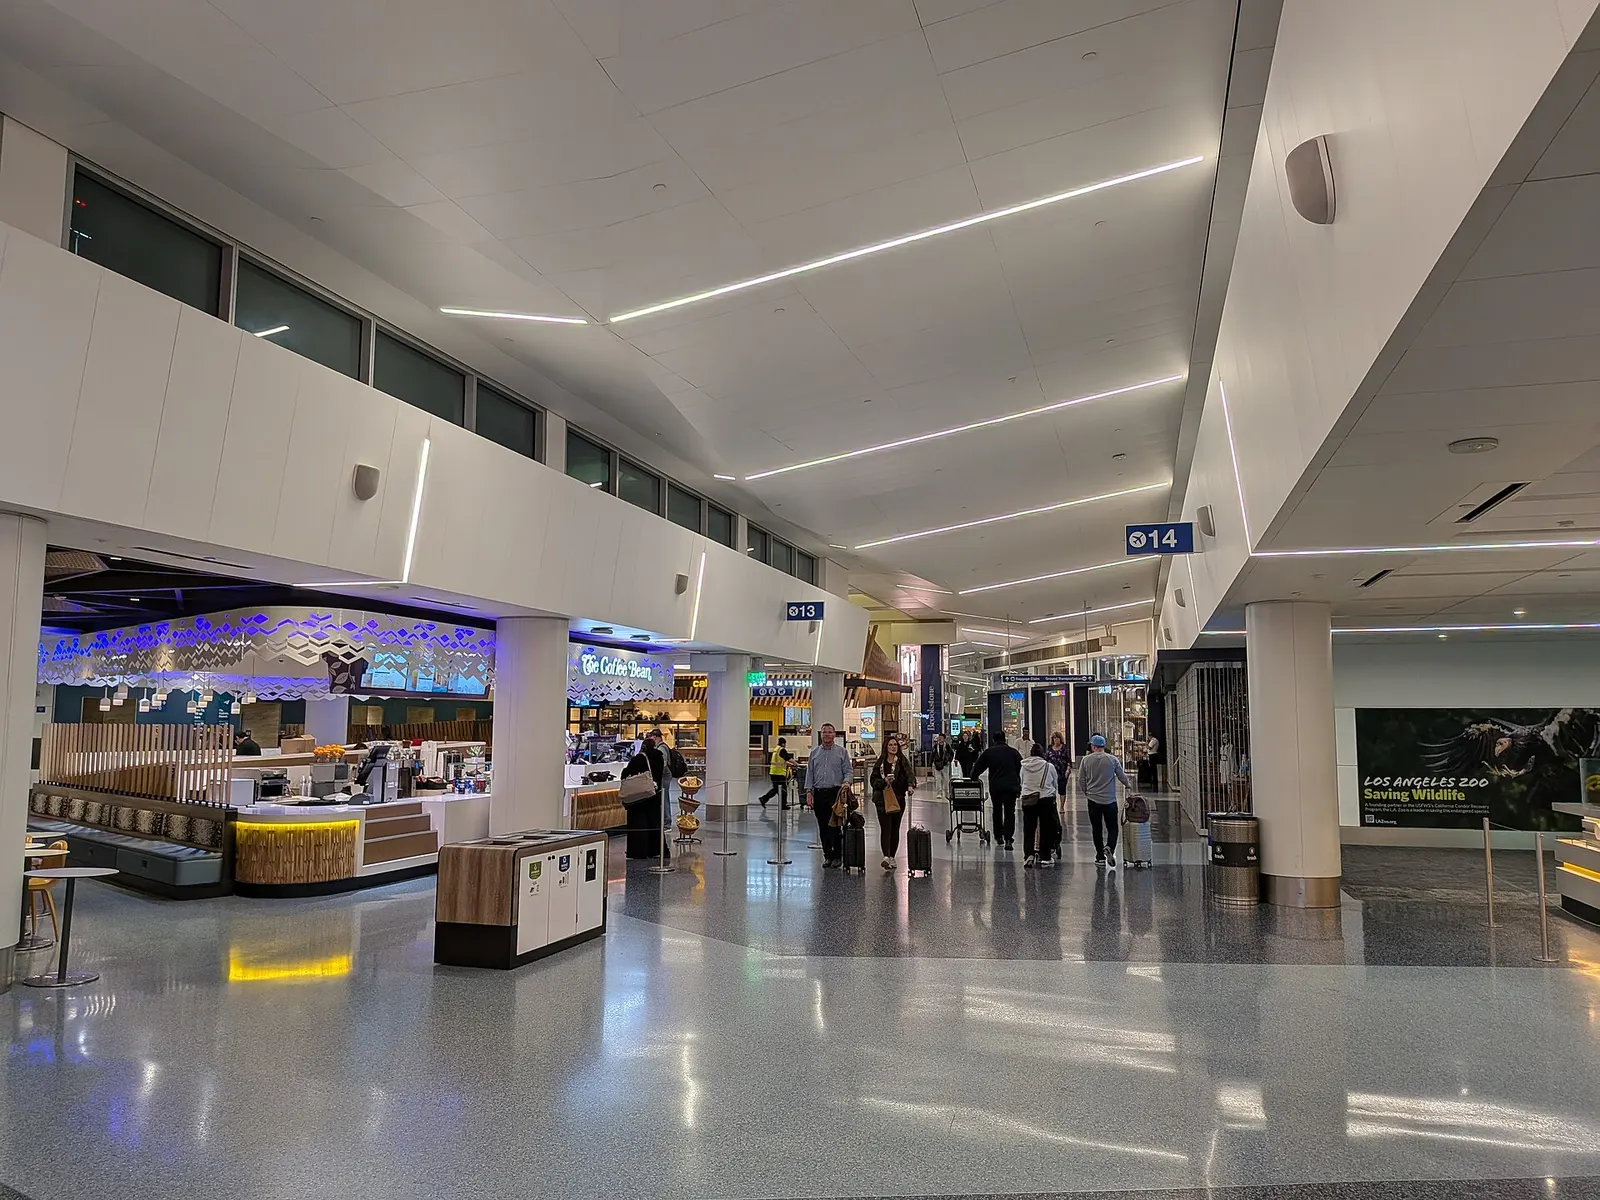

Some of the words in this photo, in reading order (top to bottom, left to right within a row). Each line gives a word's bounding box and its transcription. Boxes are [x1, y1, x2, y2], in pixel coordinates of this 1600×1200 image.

[1148, 528, 1178, 549] 14
[799, 605, 816, 617] 13
[581, 654, 600, 676] The
[600, 656, 628, 677] Coffee
[628, 660, 653, 681] Bean
[926, 685, 935, 731] Brookstone
[1364, 776, 1391, 787] LOS
[1393, 777, 1456, 789] ANGELES
[1459, 777, 1489, 788] ZOO
[1364, 788, 1409, 802] Saving
[1411, 788, 1466, 800] Wildlife
